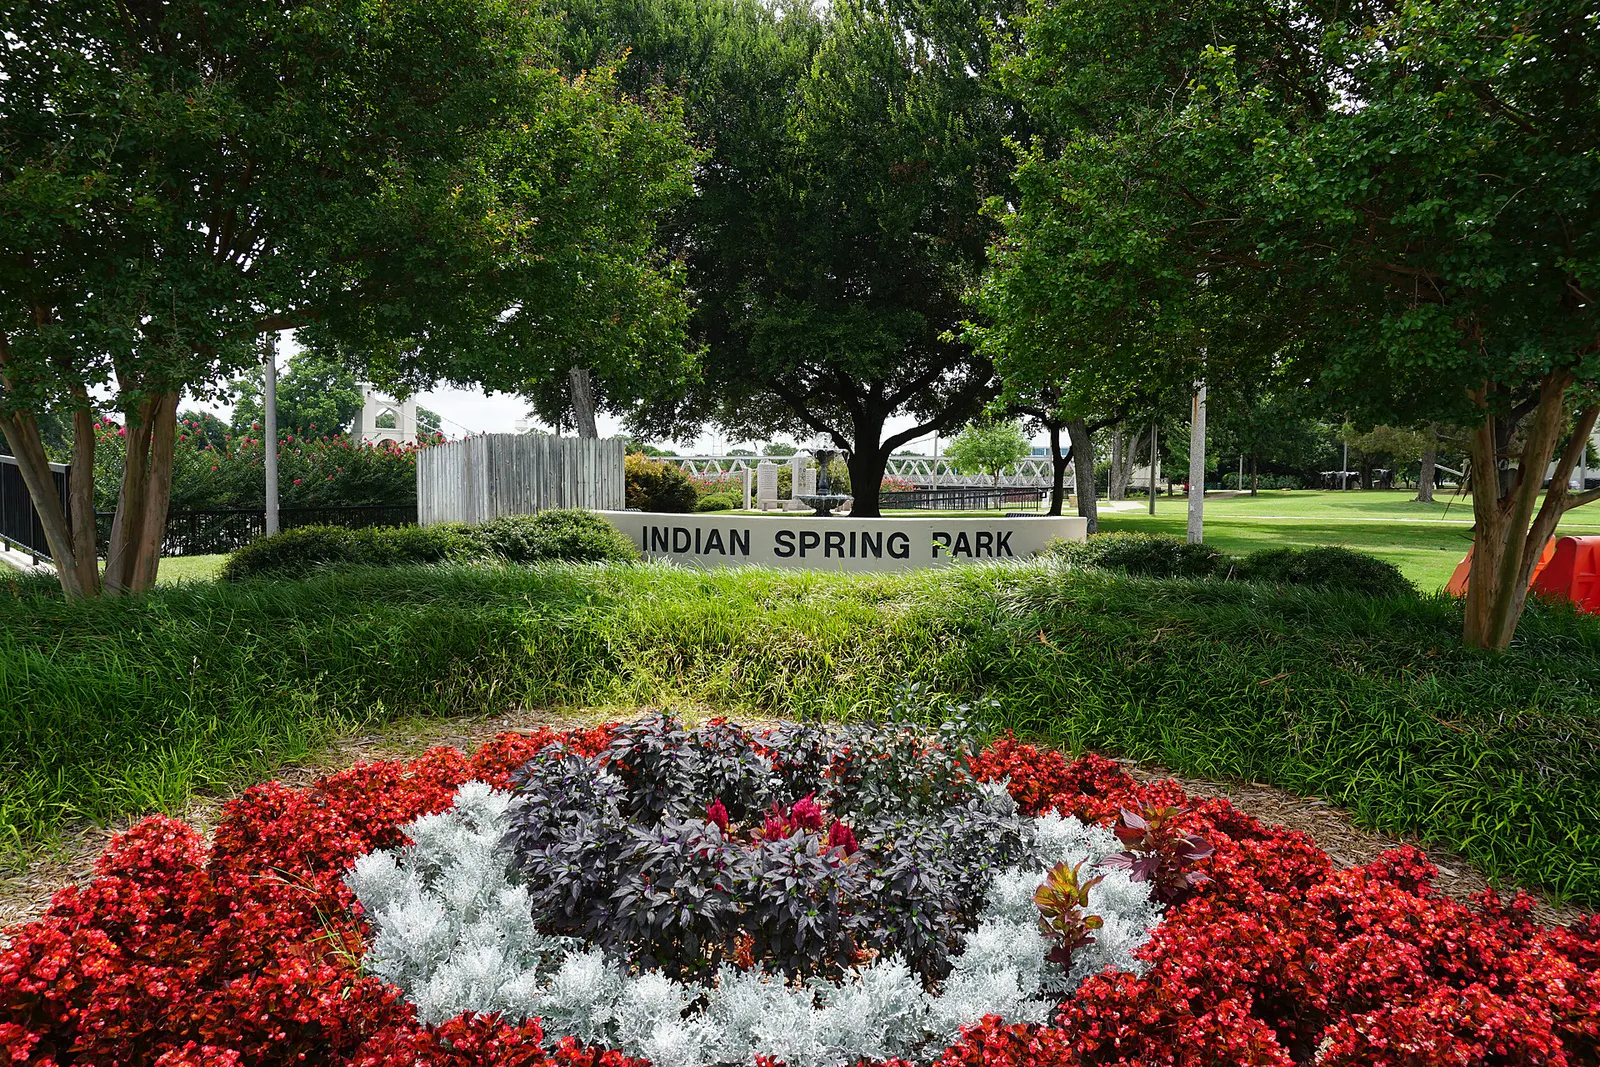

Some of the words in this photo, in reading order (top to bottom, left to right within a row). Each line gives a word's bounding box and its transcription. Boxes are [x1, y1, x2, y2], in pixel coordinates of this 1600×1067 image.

[642, 526, 750, 556] INDIAN
[774, 530, 910, 559] SPRING
[932, 531, 1013, 558] PARK
